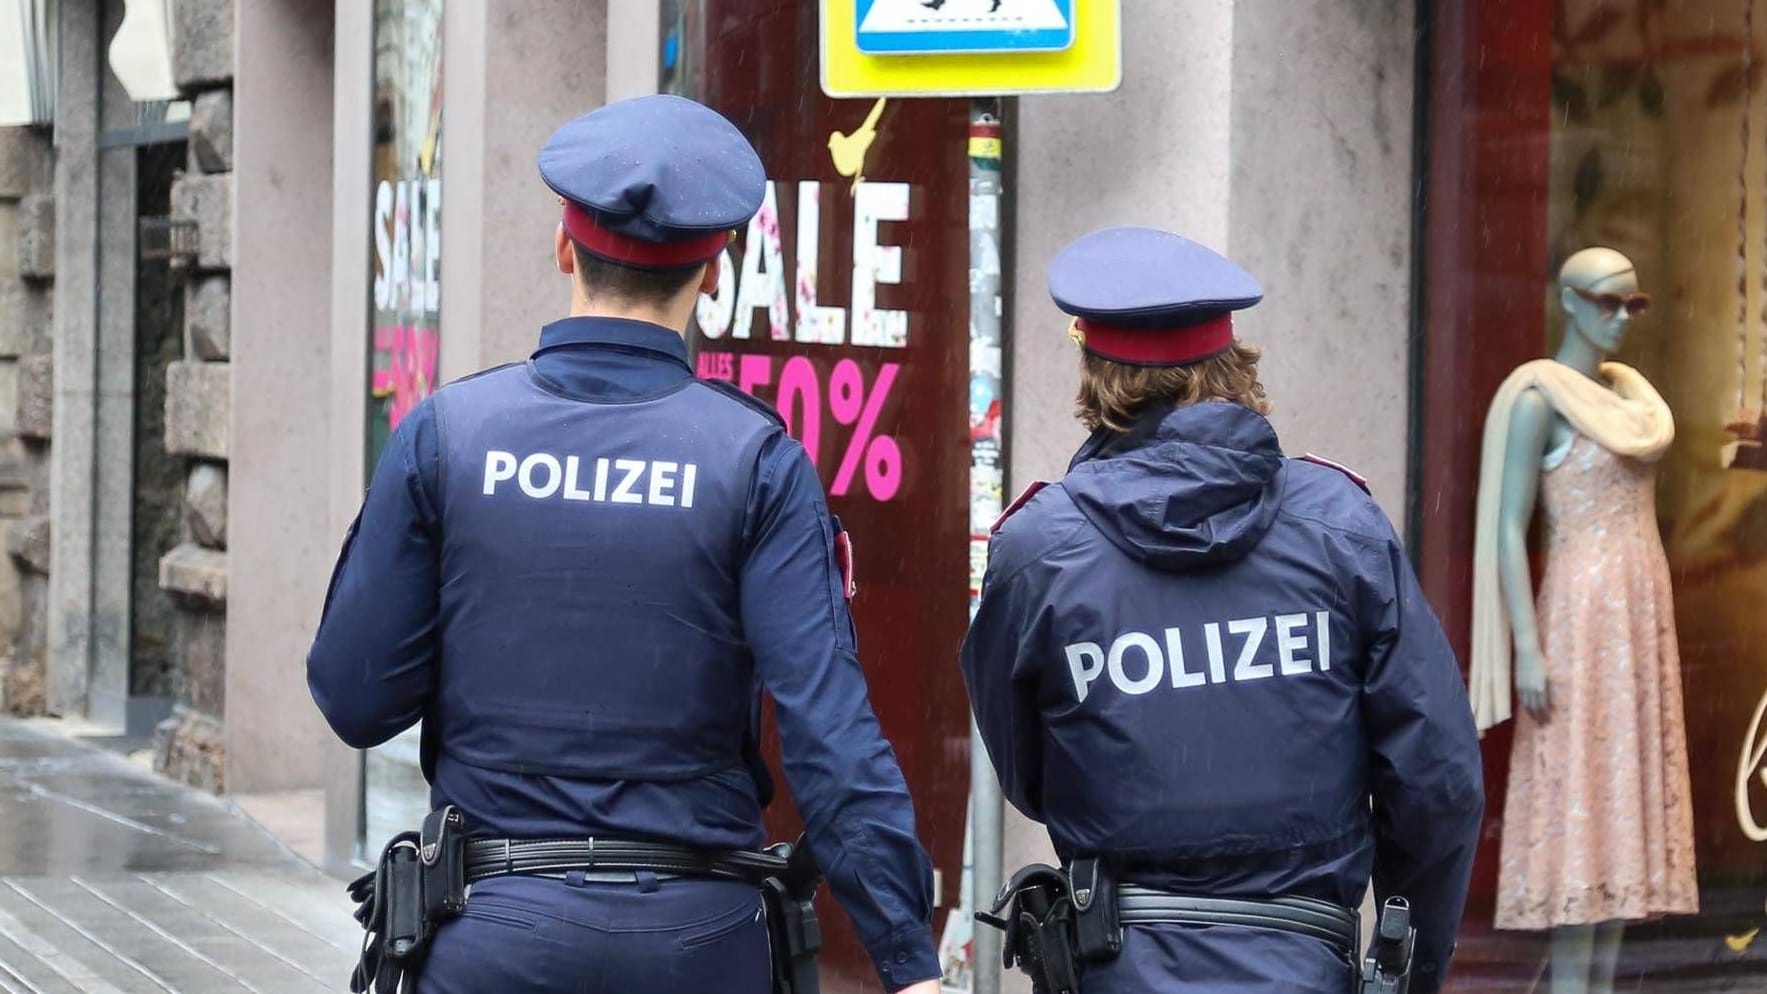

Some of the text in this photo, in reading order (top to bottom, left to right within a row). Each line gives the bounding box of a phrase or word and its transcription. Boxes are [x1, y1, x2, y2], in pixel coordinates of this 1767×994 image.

[375, 180, 440, 312] SALE
[482, 450, 697, 508] POLIZEI
[1064, 610, 1330, 703] POLIZEI
